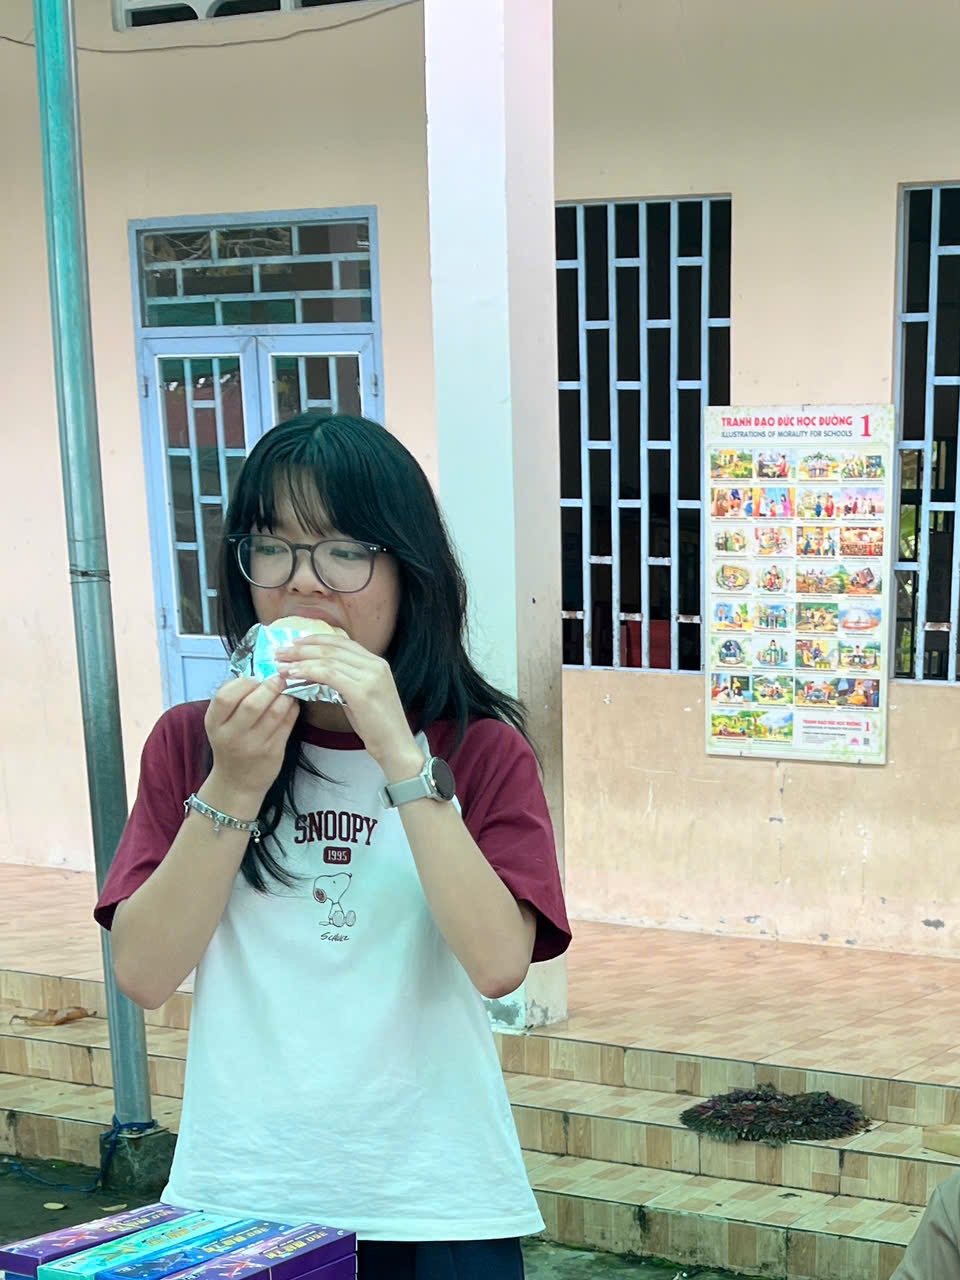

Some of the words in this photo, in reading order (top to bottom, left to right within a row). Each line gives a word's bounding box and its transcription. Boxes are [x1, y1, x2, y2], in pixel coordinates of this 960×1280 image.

[720, 430, 767, 438] ILLUSTRATIONS
[768, 430, 776, 438] OF
[777, 430, 808, 438] MORALITY
[721, 416, 752, 428] TRANH
[796, 416, 817, 429] HỌC
[860, 413, 873, 437] 1
[294, 809, 379, 846] SNOOPY
[327, 849, 348, 862] 1995
